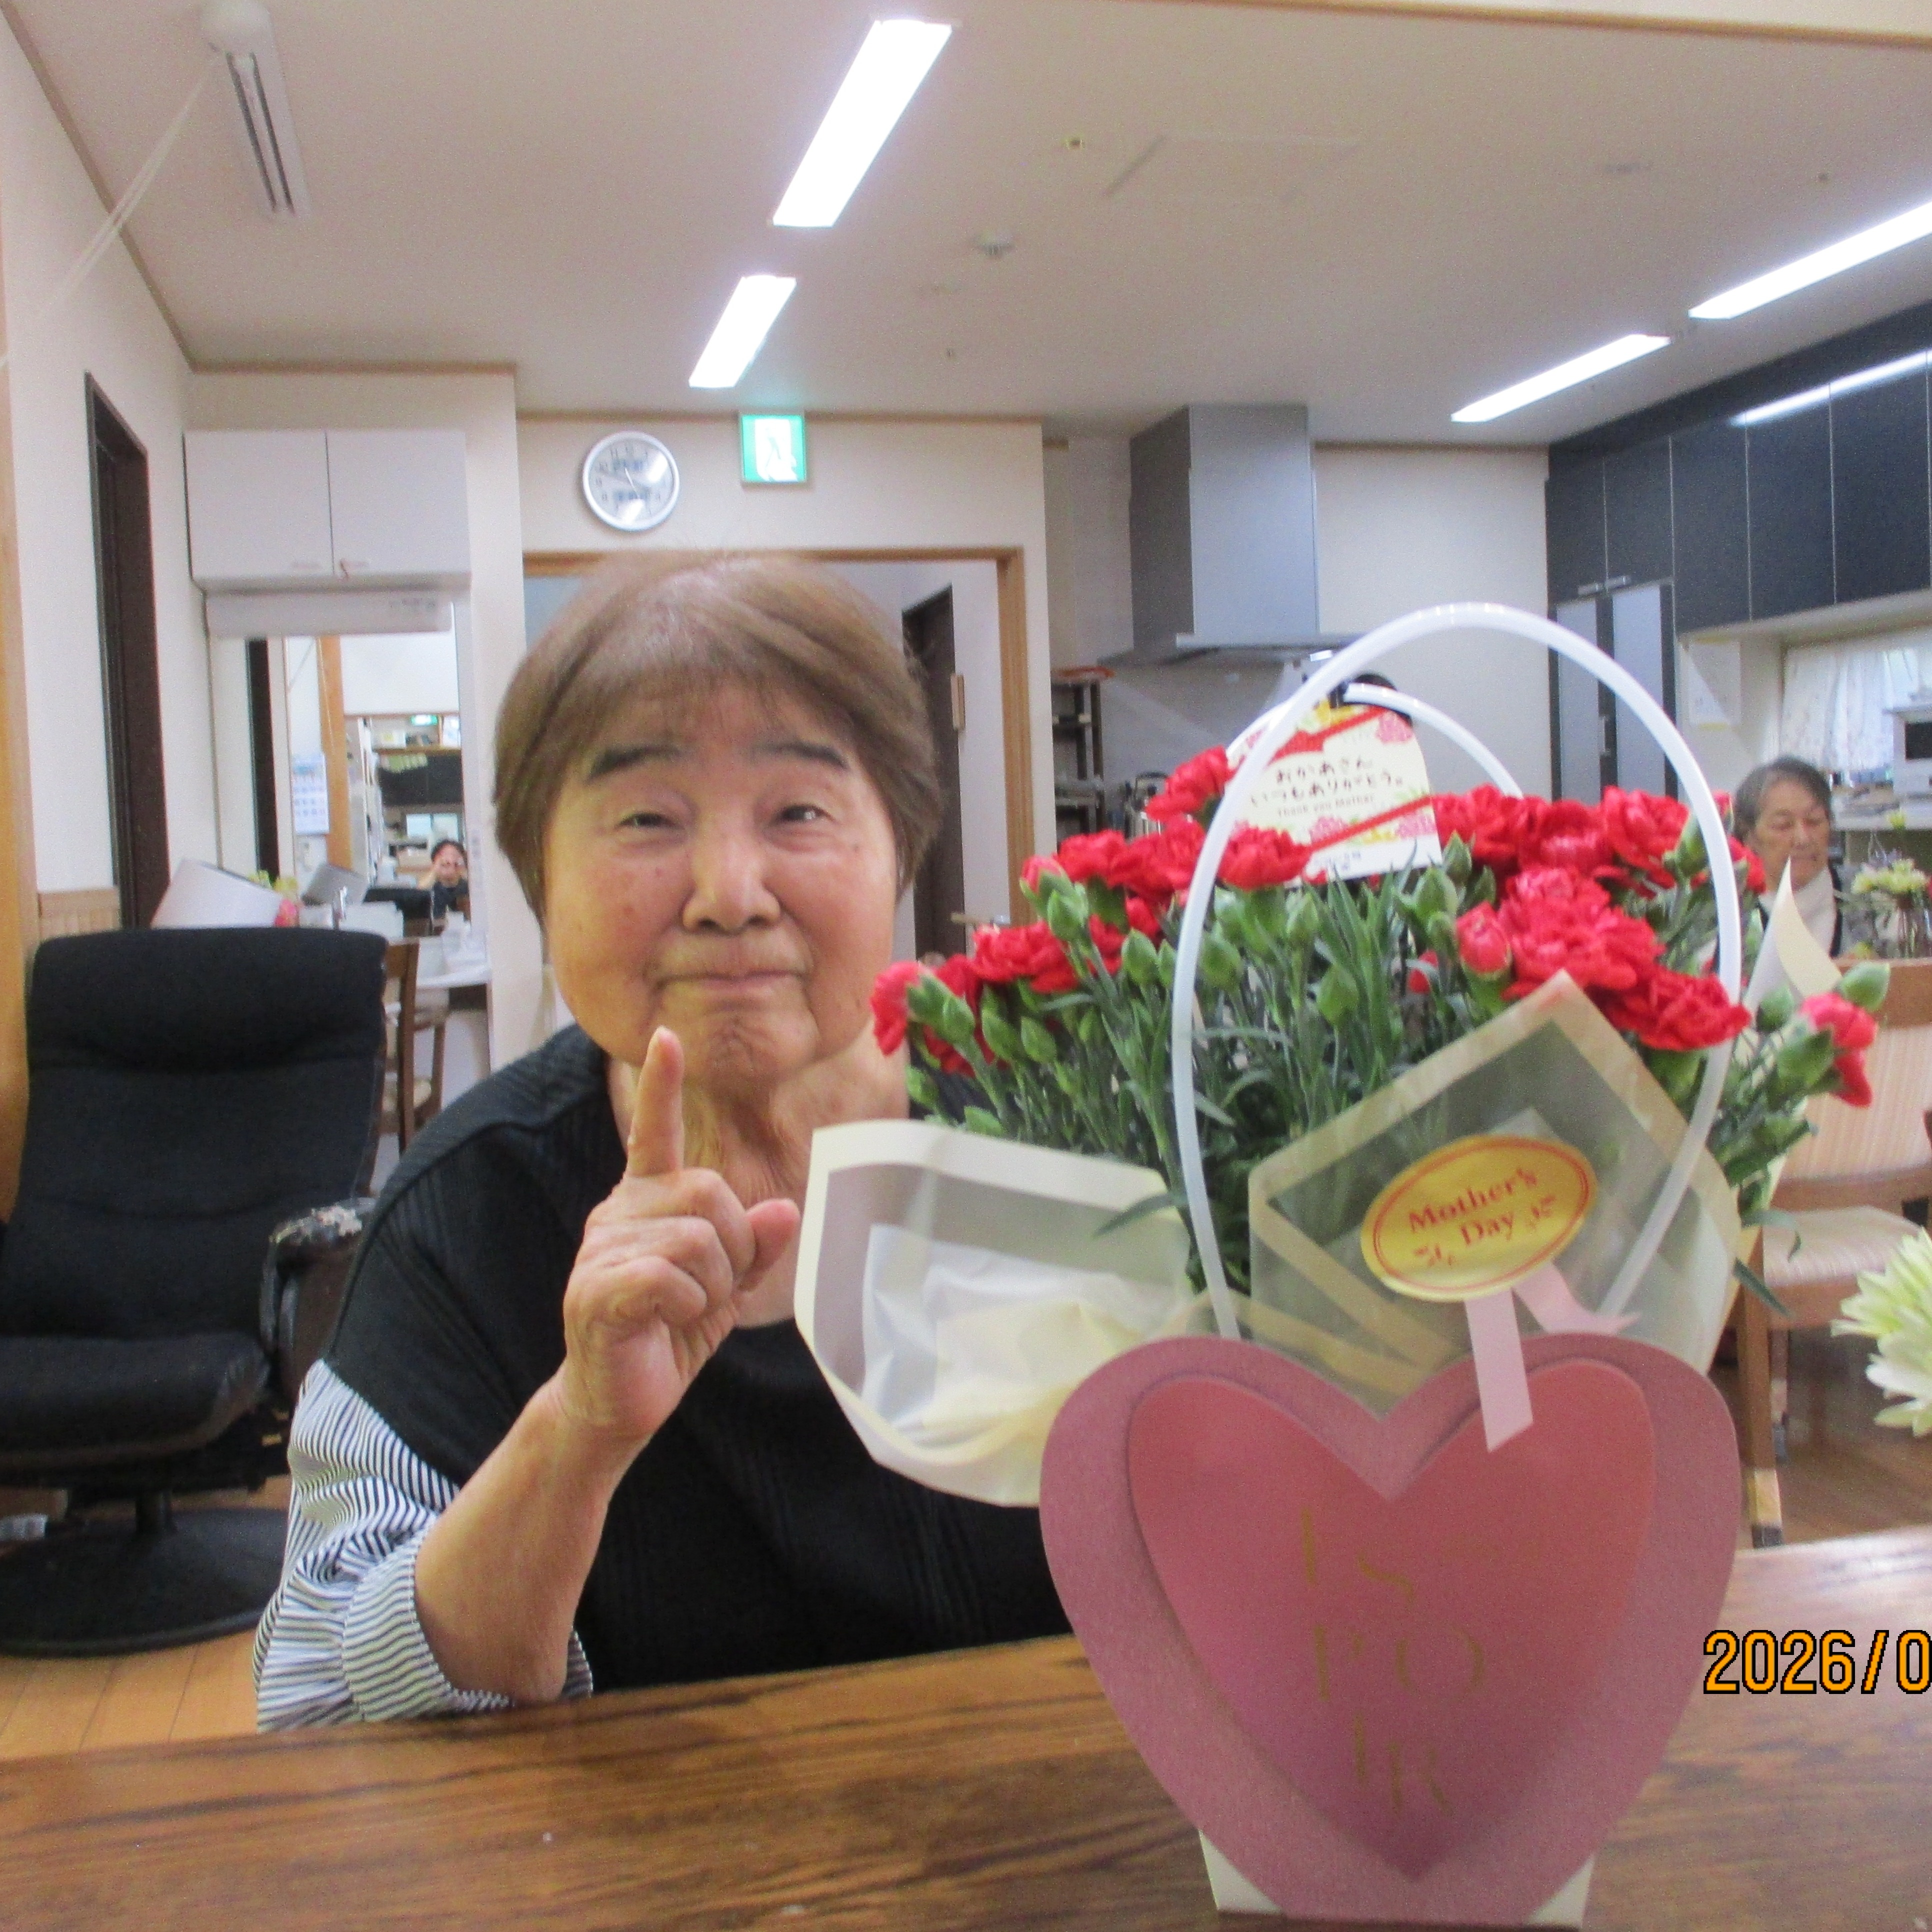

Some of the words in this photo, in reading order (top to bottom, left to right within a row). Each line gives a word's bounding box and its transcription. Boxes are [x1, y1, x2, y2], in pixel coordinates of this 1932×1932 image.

[1276, 755, 1373, 784] おかあさん
[1409, 1168, 1538, 1233] Mother's
[1460, 1211, 1515, 1246] Day
